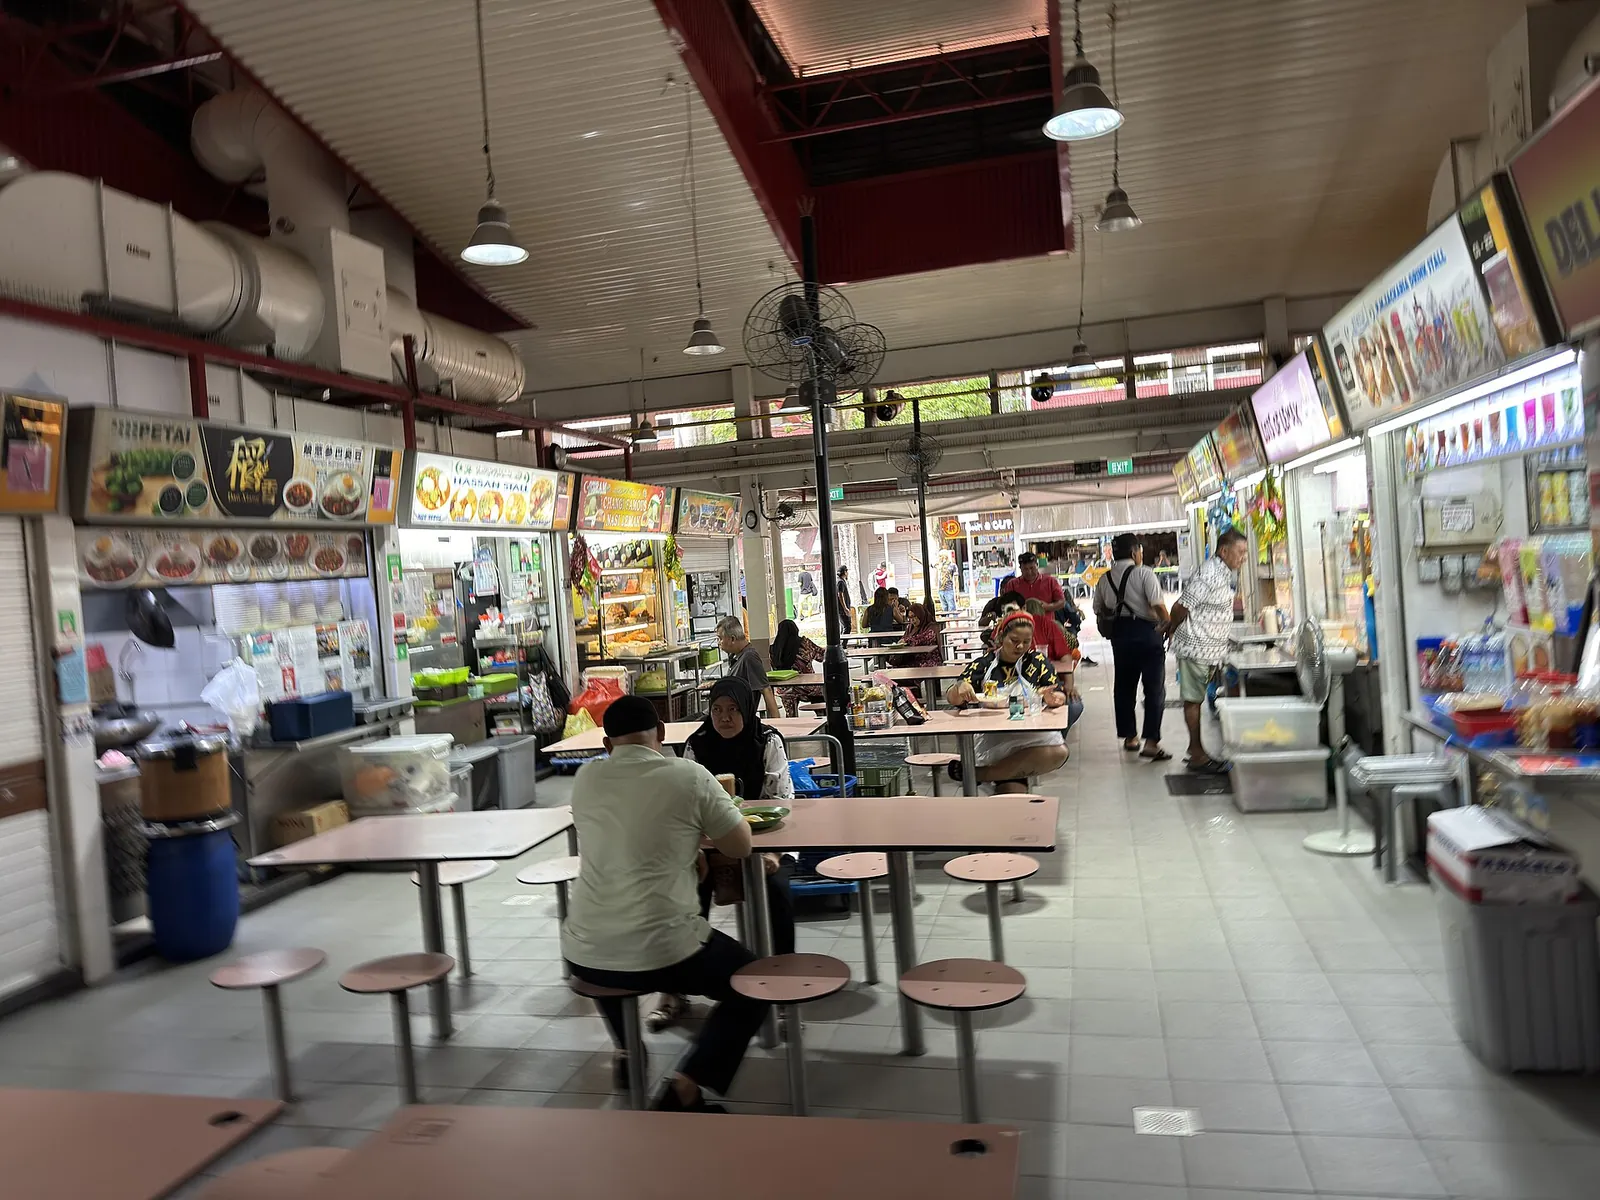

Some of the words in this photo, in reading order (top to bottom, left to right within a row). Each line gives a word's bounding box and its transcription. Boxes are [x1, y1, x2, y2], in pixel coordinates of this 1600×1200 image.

[1111, 460, 1130, 475] EXIT
[453, 477, 500, 489] HASSAN
[503, 482, 529, 493] STALL
[603, 496, 624, 510] CHANGI
[625, 498, 647, 512] FAMOUS
[605, 514, 620, 527] NASI
[621, 515, 642, 528] LEMAK
